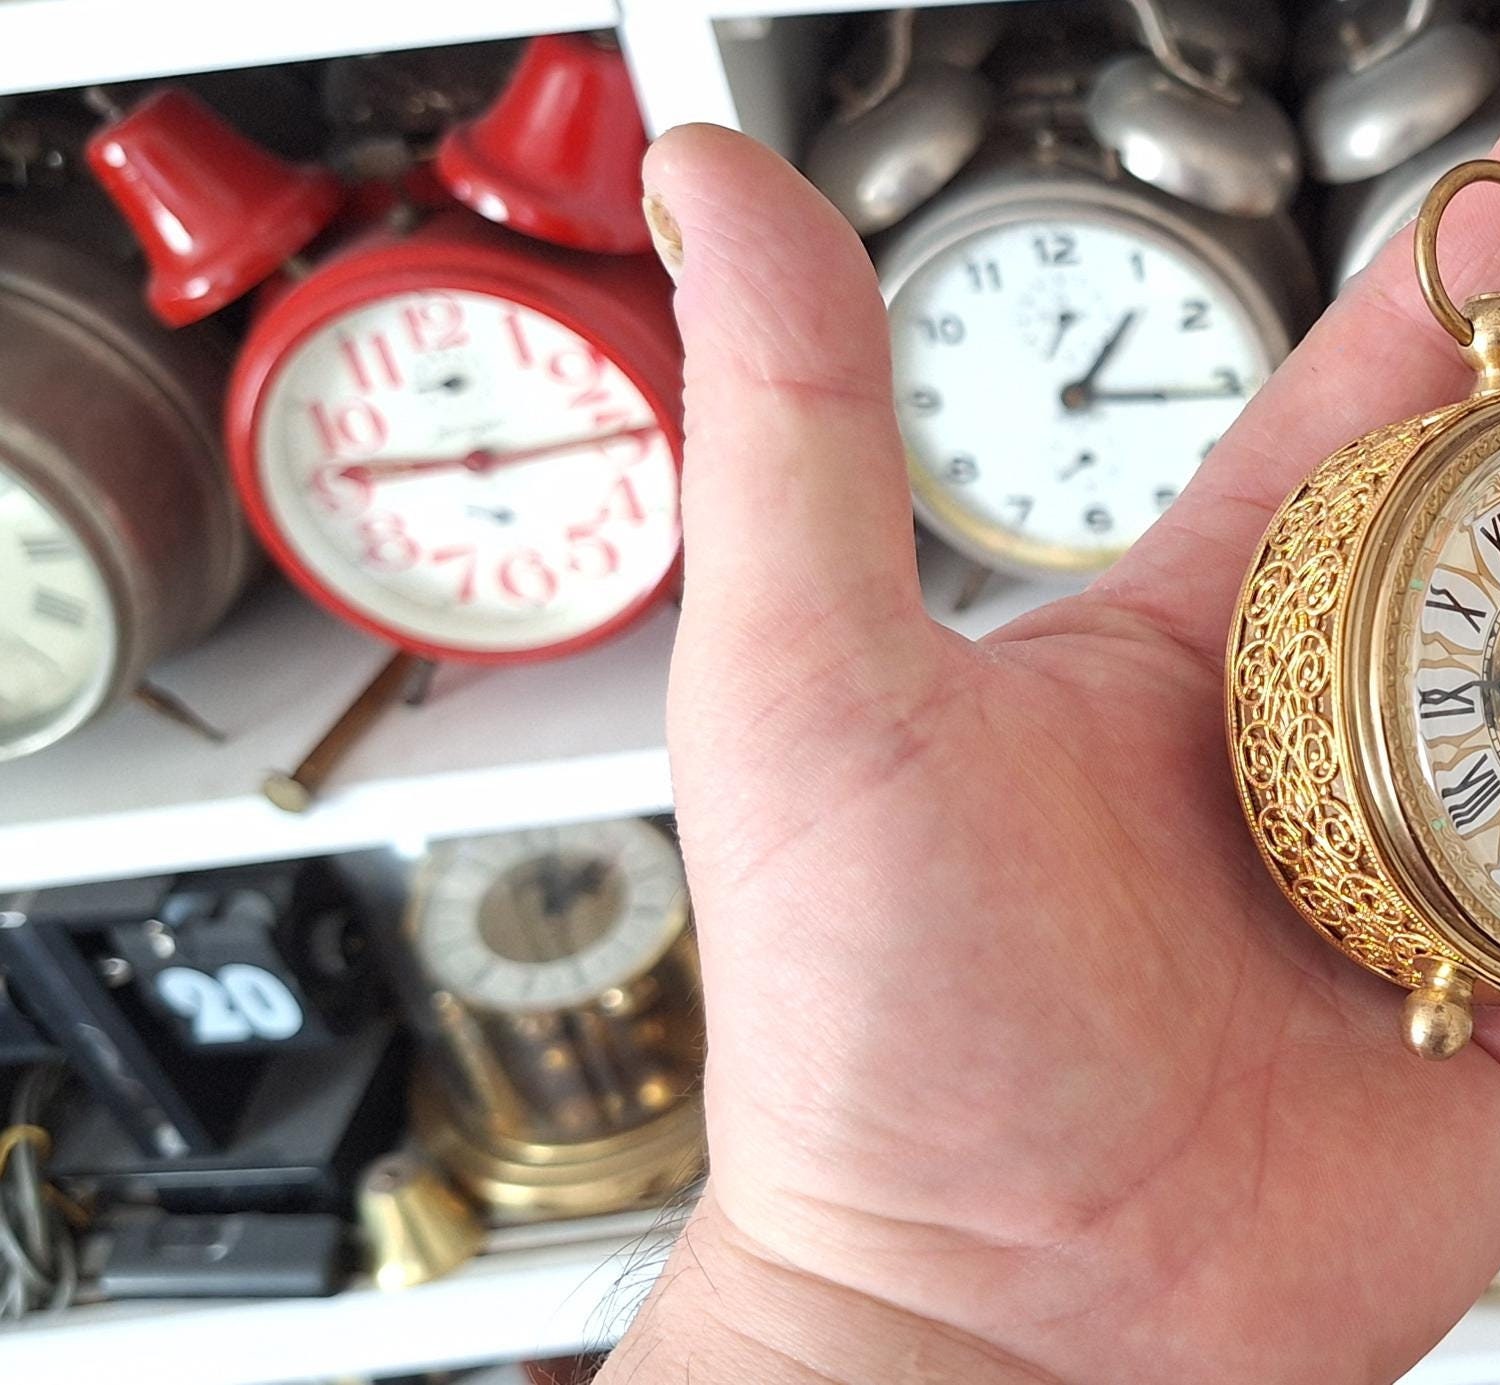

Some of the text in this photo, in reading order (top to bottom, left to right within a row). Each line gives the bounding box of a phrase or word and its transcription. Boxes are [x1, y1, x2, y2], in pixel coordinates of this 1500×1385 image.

[1032, 234, 1080, 266] 12
[1130, 251, 1146, 283] 1
[966, 260, 1002, 291] 11
[403, 300, 471, 353] 12
[919, 313, 965, 344] 10
[1179, 299, 1211, 333] 2
[338, 332, 404, 393] 11
[502, 312, 535, 370] 1
[309, 399, 389, 456] 10
[1004, 496, 1034, 528] 7
[431, 545, 477, 605] 7
[1424, 583, 1487, 634] X
[1418, 679, 1476, 719] IX
[157, 963, 302, 1045] 20
